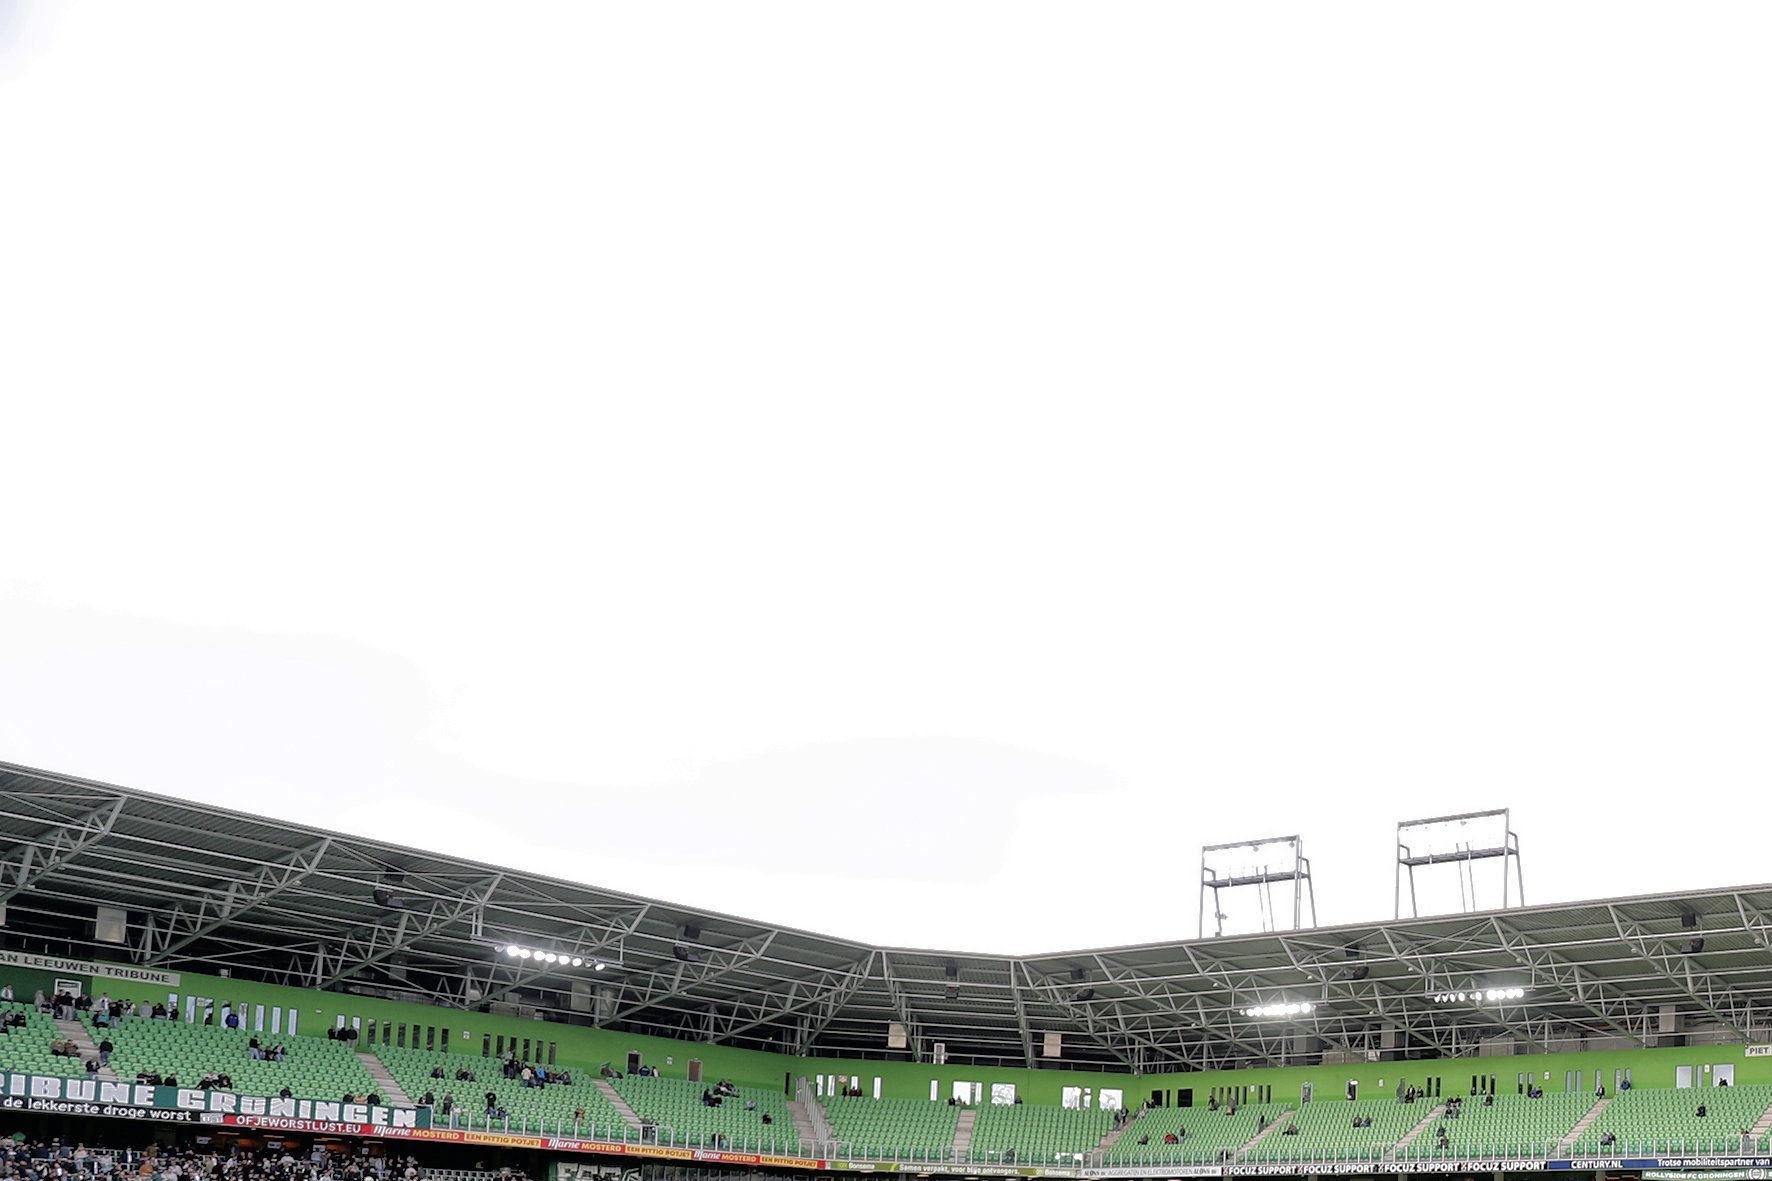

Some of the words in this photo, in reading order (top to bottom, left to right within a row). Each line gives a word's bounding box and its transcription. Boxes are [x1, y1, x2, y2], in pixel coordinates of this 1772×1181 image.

[24, 956, 99, 973] LEEUWEN
[105, 967, 170, 983] TRIBUNE
[4, 1096, 23, 1108] de
[28, 1097, 100, 1115] lekkerste
[103, 1104, 146, 1119] droge
[150, 1108, 192, 1122] worst
[373, 1125, 411, 1137] Marne
[412, 1129, 460, 1140] MOSTERD
[548, 1138, 580, 1149] Marne
[581, 1143, 622, 1152] MOSTERD
[721, 1154, 757, 1162] MOSTERD
[1657, 1158, 1682, 1167] Trotse
[1683, 1158, 1755, 1168] mobiliteitspartner
[922, 1165, 950, 1173] verpakt,
[1229, 1165, 1257, 1175] FOCUZ
[1258, 1165, 1297, 1175] SUPPORT
[1304, 1165, 1333, 1174] FOCUZ
[1334, 1164, 1375, 1173] SUPPORT
[1384, 1163, 1415, 1173] FOCUZ
[1416, 1163, 1458, 1172] SUPPORT
[1468, 1162, 1499, 1171] FOCUZ
[1500, 1161, 1546, 1170] SUPPORT
[1571, 1160, 1623, 1169] CENTURY.NL
[1697, 1171, 1745, 1179] GRONINGEN
